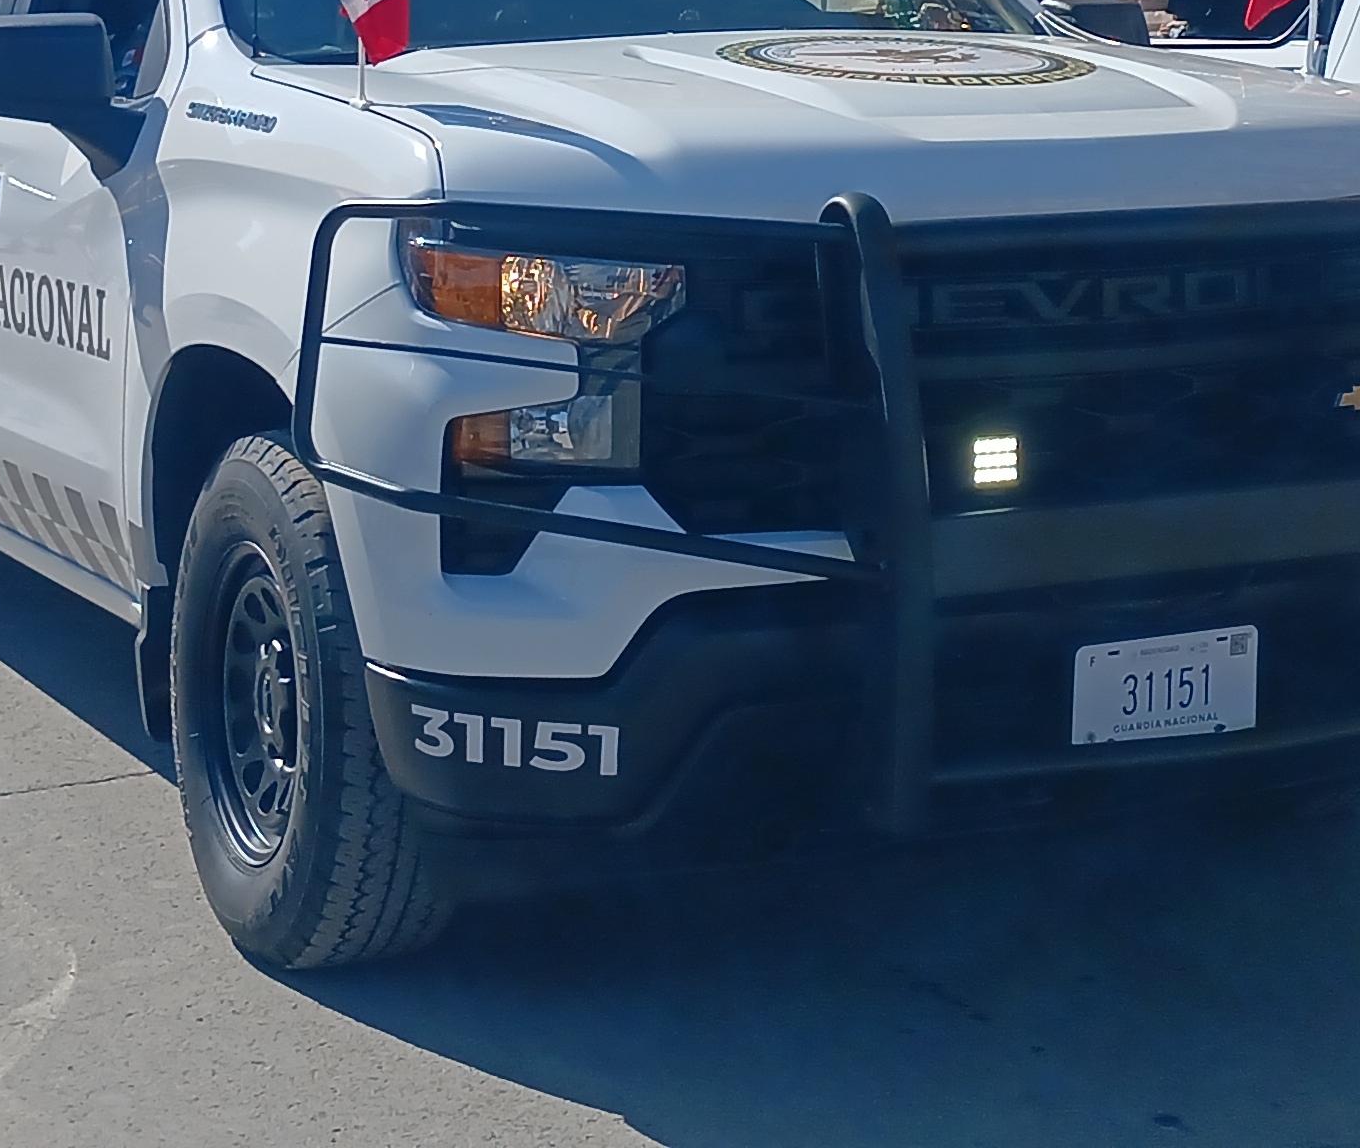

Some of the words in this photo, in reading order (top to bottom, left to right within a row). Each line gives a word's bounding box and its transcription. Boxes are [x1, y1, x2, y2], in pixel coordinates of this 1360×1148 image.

[1122, 664, 1210, 716] 31151
[411, 703, 620, 776] 31151
[1113, 720, 1162, 734] GUARDIA
[1164, 712, 1219, 728] NACIONAL
